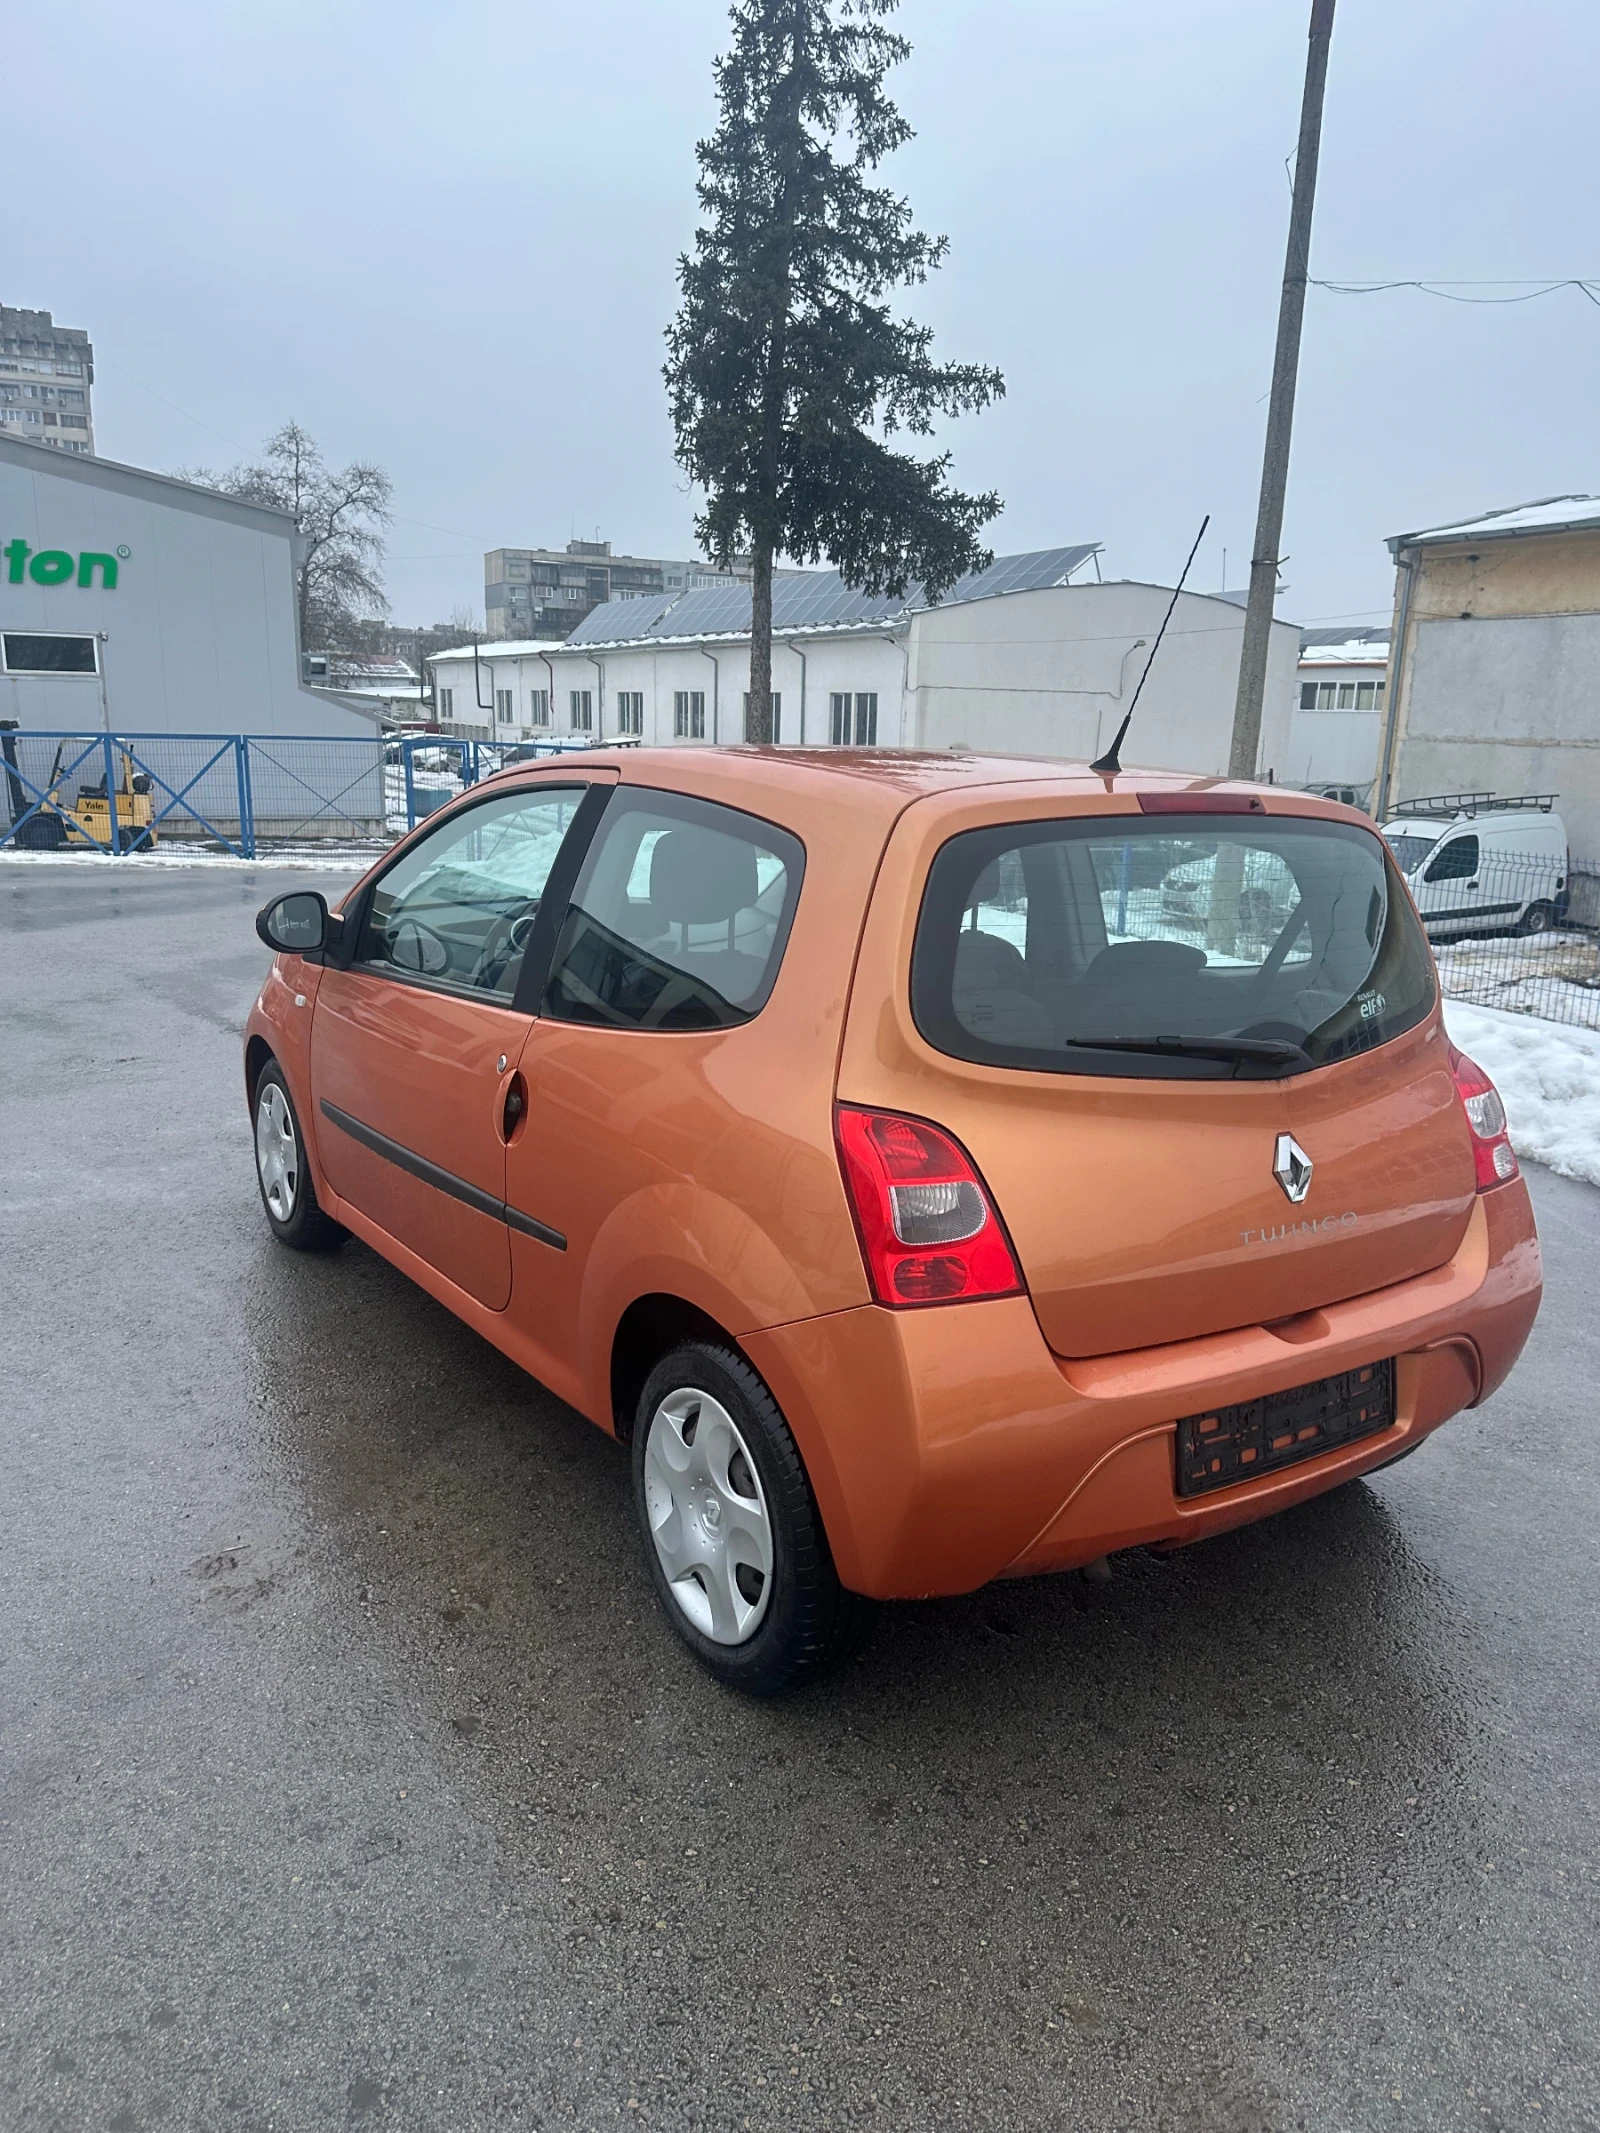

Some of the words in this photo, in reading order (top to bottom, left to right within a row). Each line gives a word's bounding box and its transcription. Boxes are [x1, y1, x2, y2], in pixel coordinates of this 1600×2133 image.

[0, 538, 118, 589] ton
[85, 800, 104, 810] Yale
[1360, 998, 1376, 1018] elf
[1239, 1211, 1358, 1246] TWINGO
